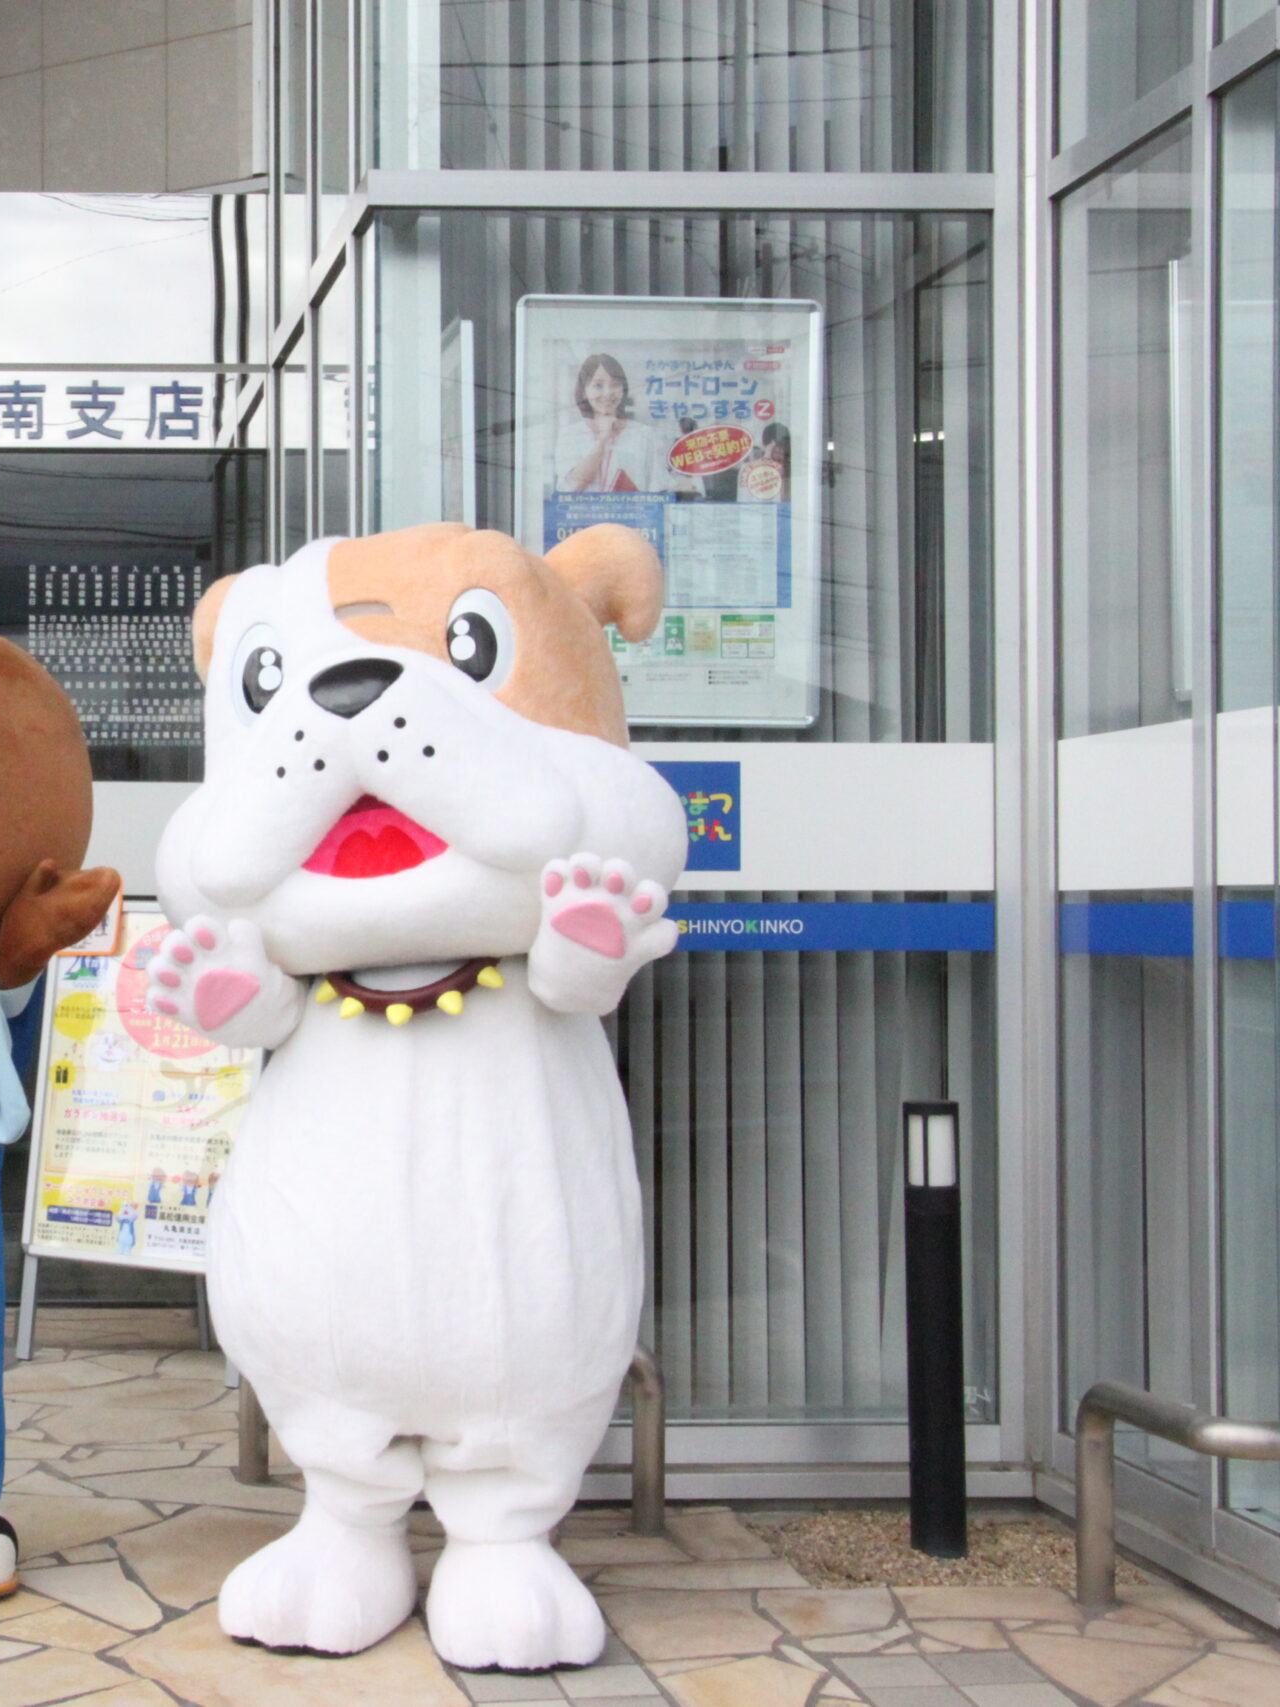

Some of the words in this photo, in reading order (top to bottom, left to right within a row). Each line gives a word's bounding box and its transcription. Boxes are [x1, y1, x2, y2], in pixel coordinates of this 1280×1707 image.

[645, 375, 758, 395] カードローン
[680, 791, 733, 815] まつ
[676, 918, 804, 935] SHINYOKINKO
